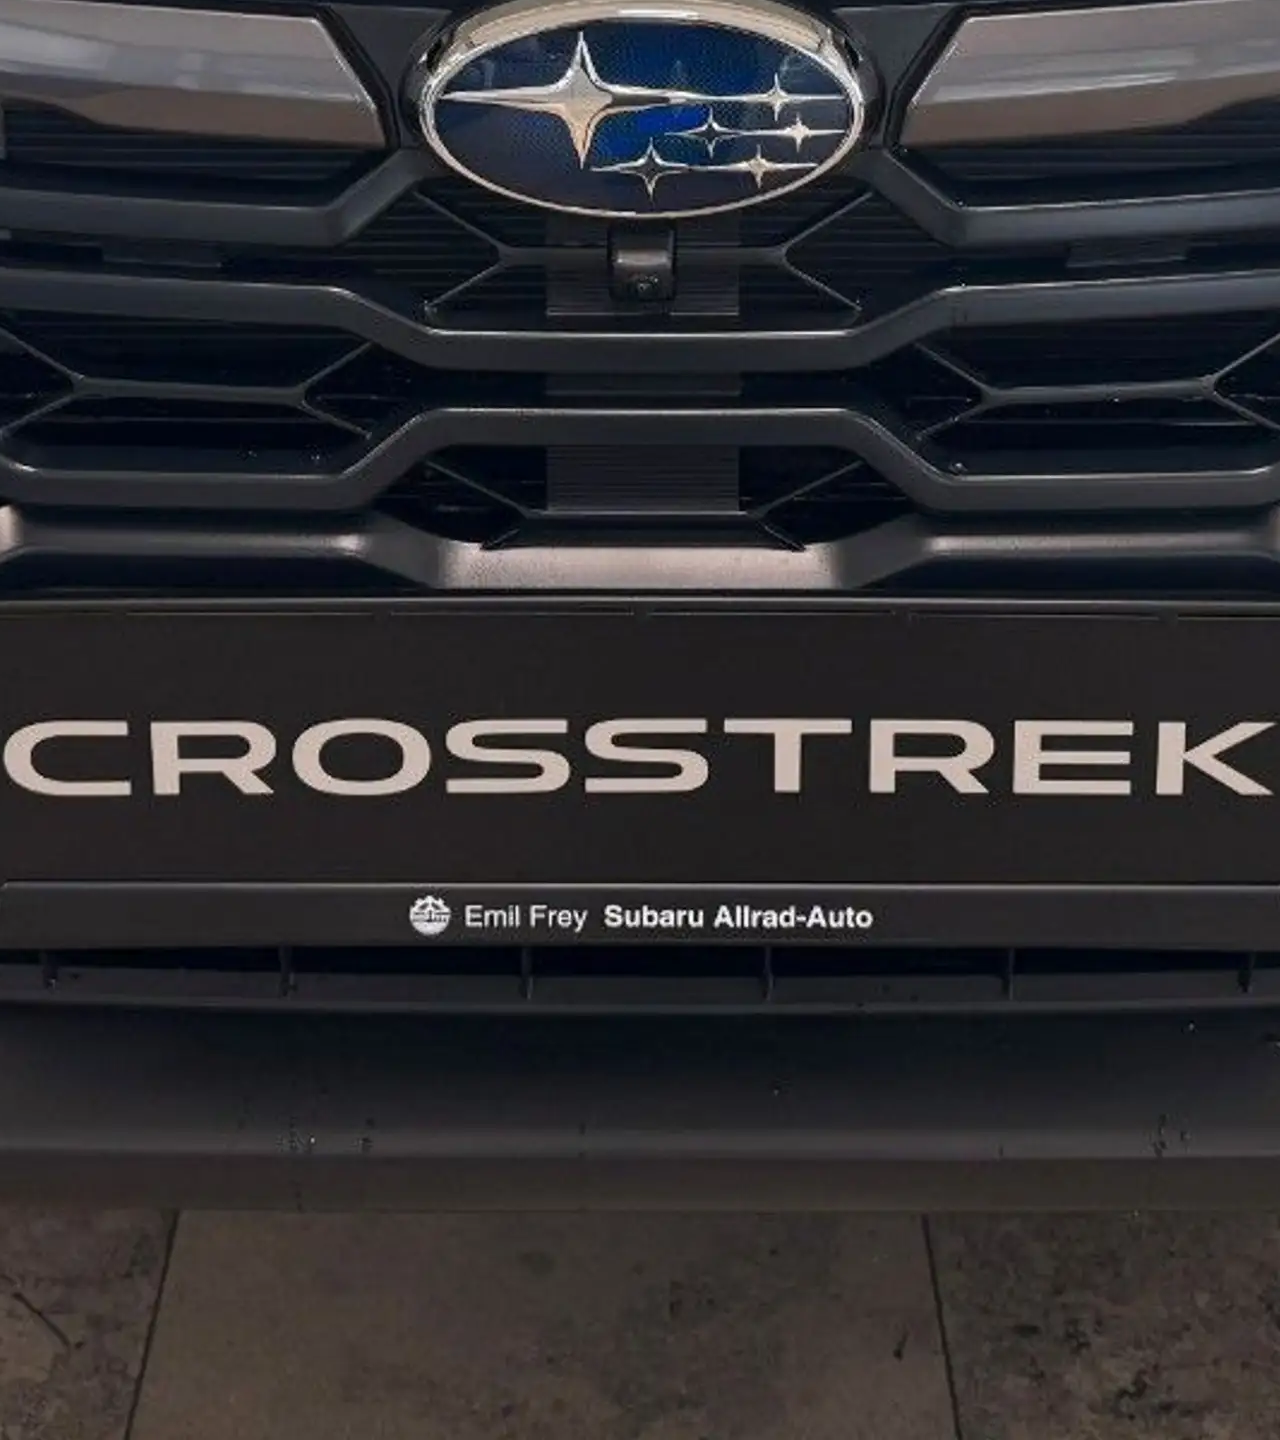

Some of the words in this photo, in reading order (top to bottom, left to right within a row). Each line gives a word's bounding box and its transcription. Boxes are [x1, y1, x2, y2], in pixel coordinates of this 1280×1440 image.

[3, 718, 1275, 796] CROSSTREK
[464, 904, 521, 928] Emil
[529, 904, 588, 933] Frey
[604, 904, 704, 928] Subaru
[713, 904, 874, 929] Allrad-Auto
